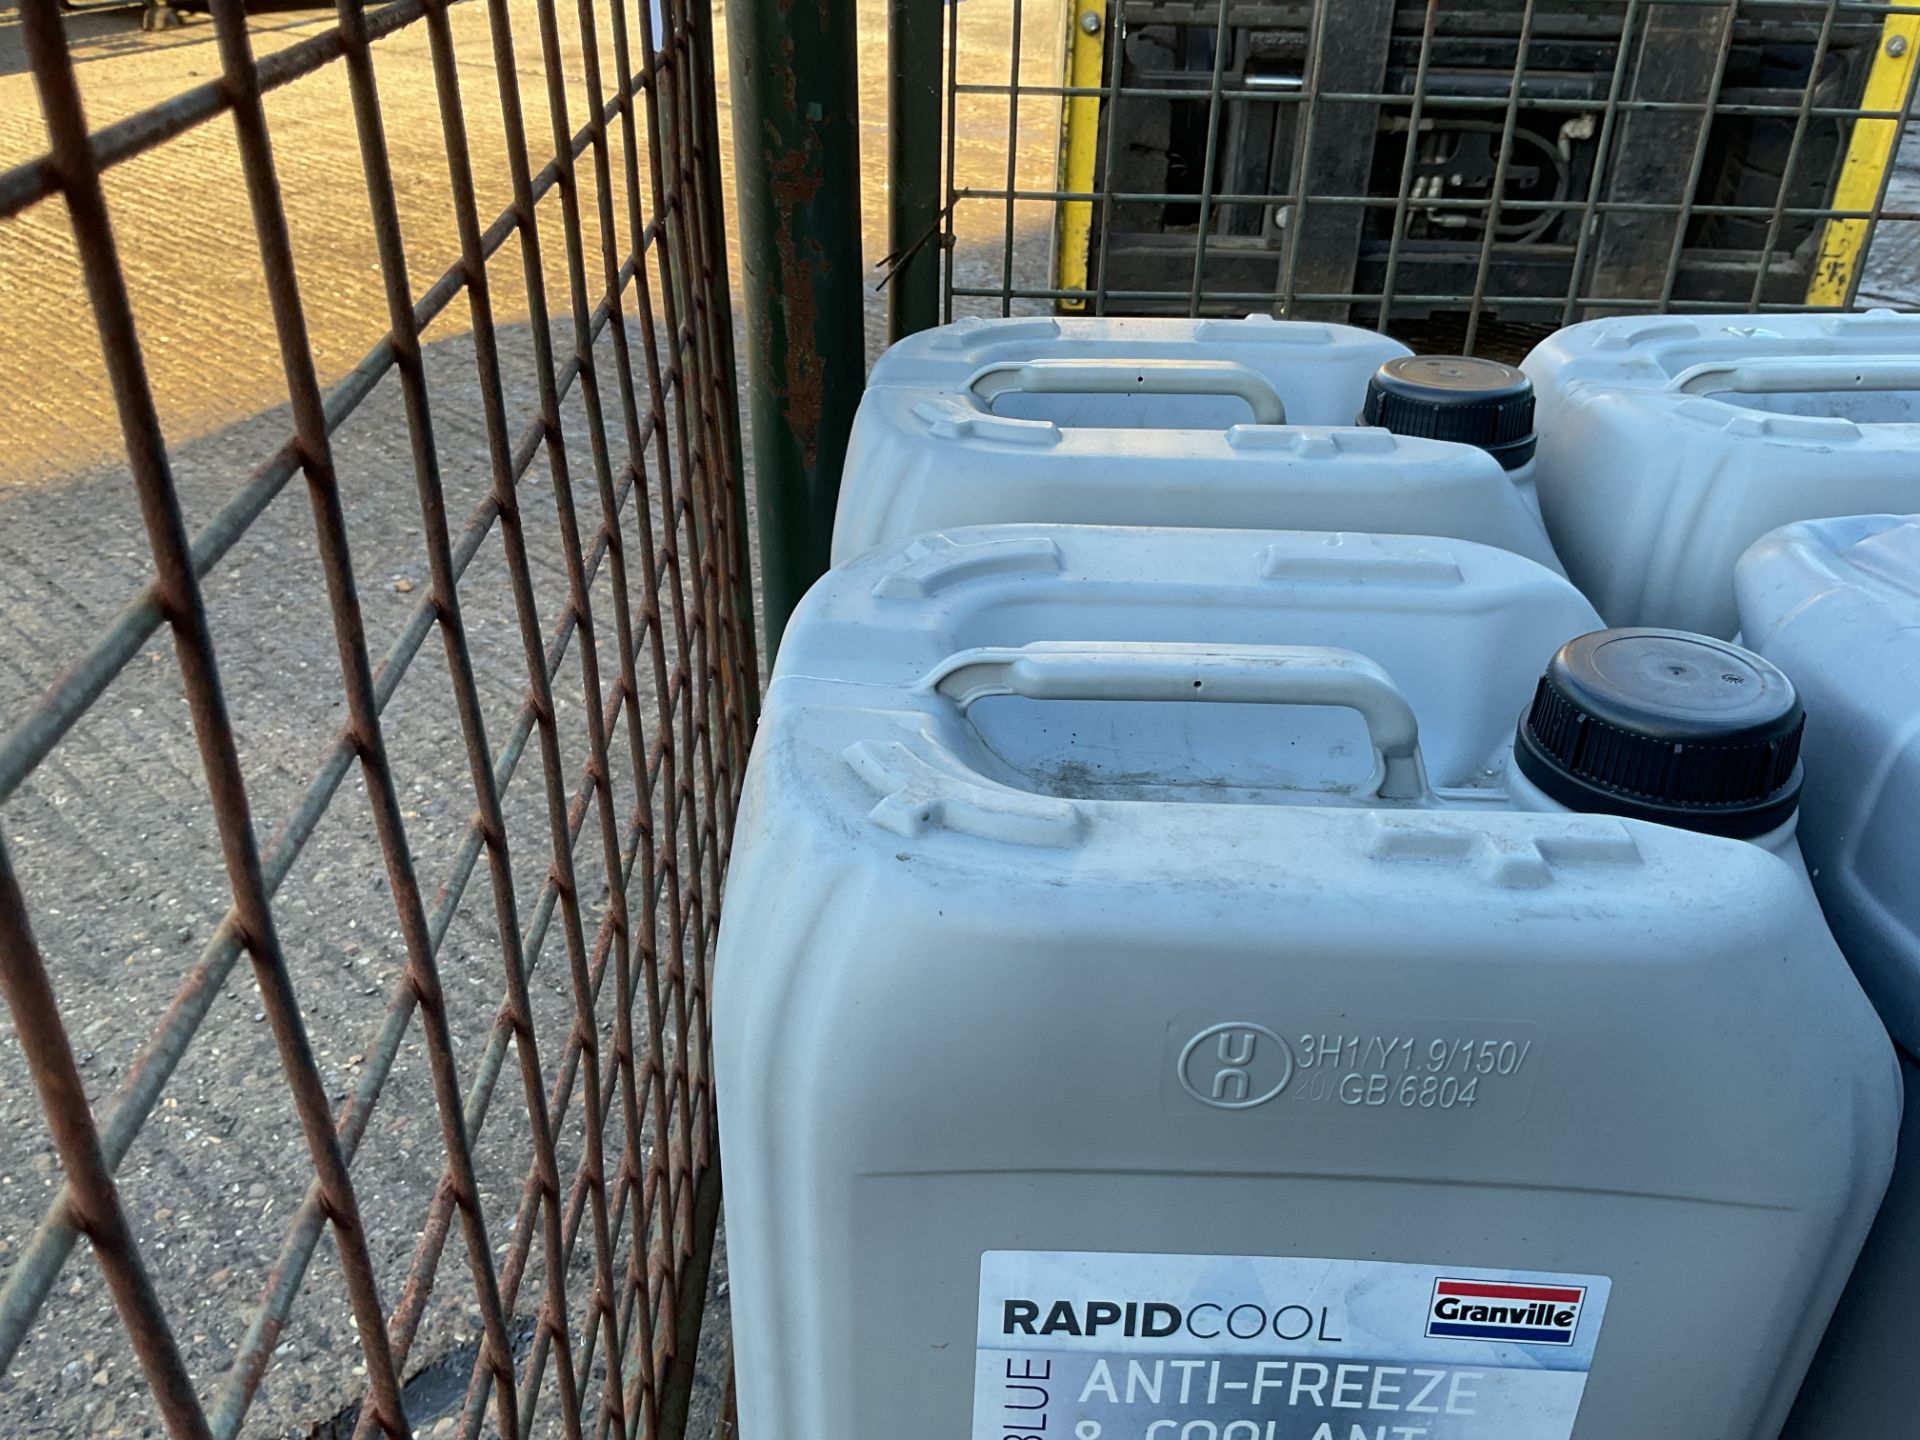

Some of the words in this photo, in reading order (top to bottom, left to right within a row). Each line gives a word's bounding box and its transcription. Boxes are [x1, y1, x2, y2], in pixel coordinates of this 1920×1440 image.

[1001, 1298, 1343, 1343] RAPIDCOOL
[1433, 1297, 1576, 1328] Granville
[1077, 1358, 1486, 1416] ANTI-FREEZE
